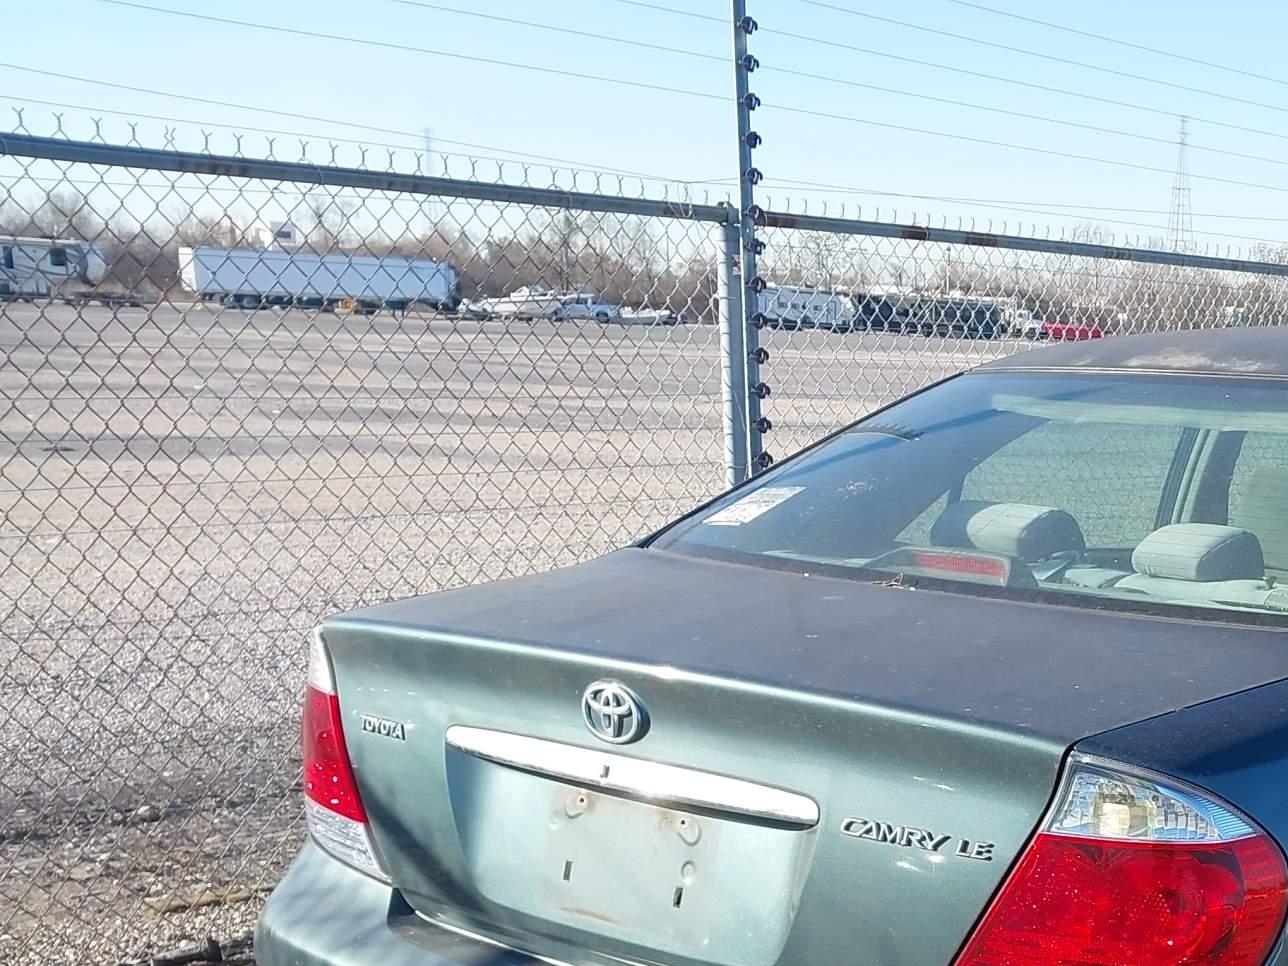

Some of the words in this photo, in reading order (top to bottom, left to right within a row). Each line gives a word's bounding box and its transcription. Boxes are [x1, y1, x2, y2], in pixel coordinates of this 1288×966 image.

[359, 713, 406, 741] TOYOTA
[840, 816, 952, 851] CAMRY
[954, 837, 995, 861] LE
